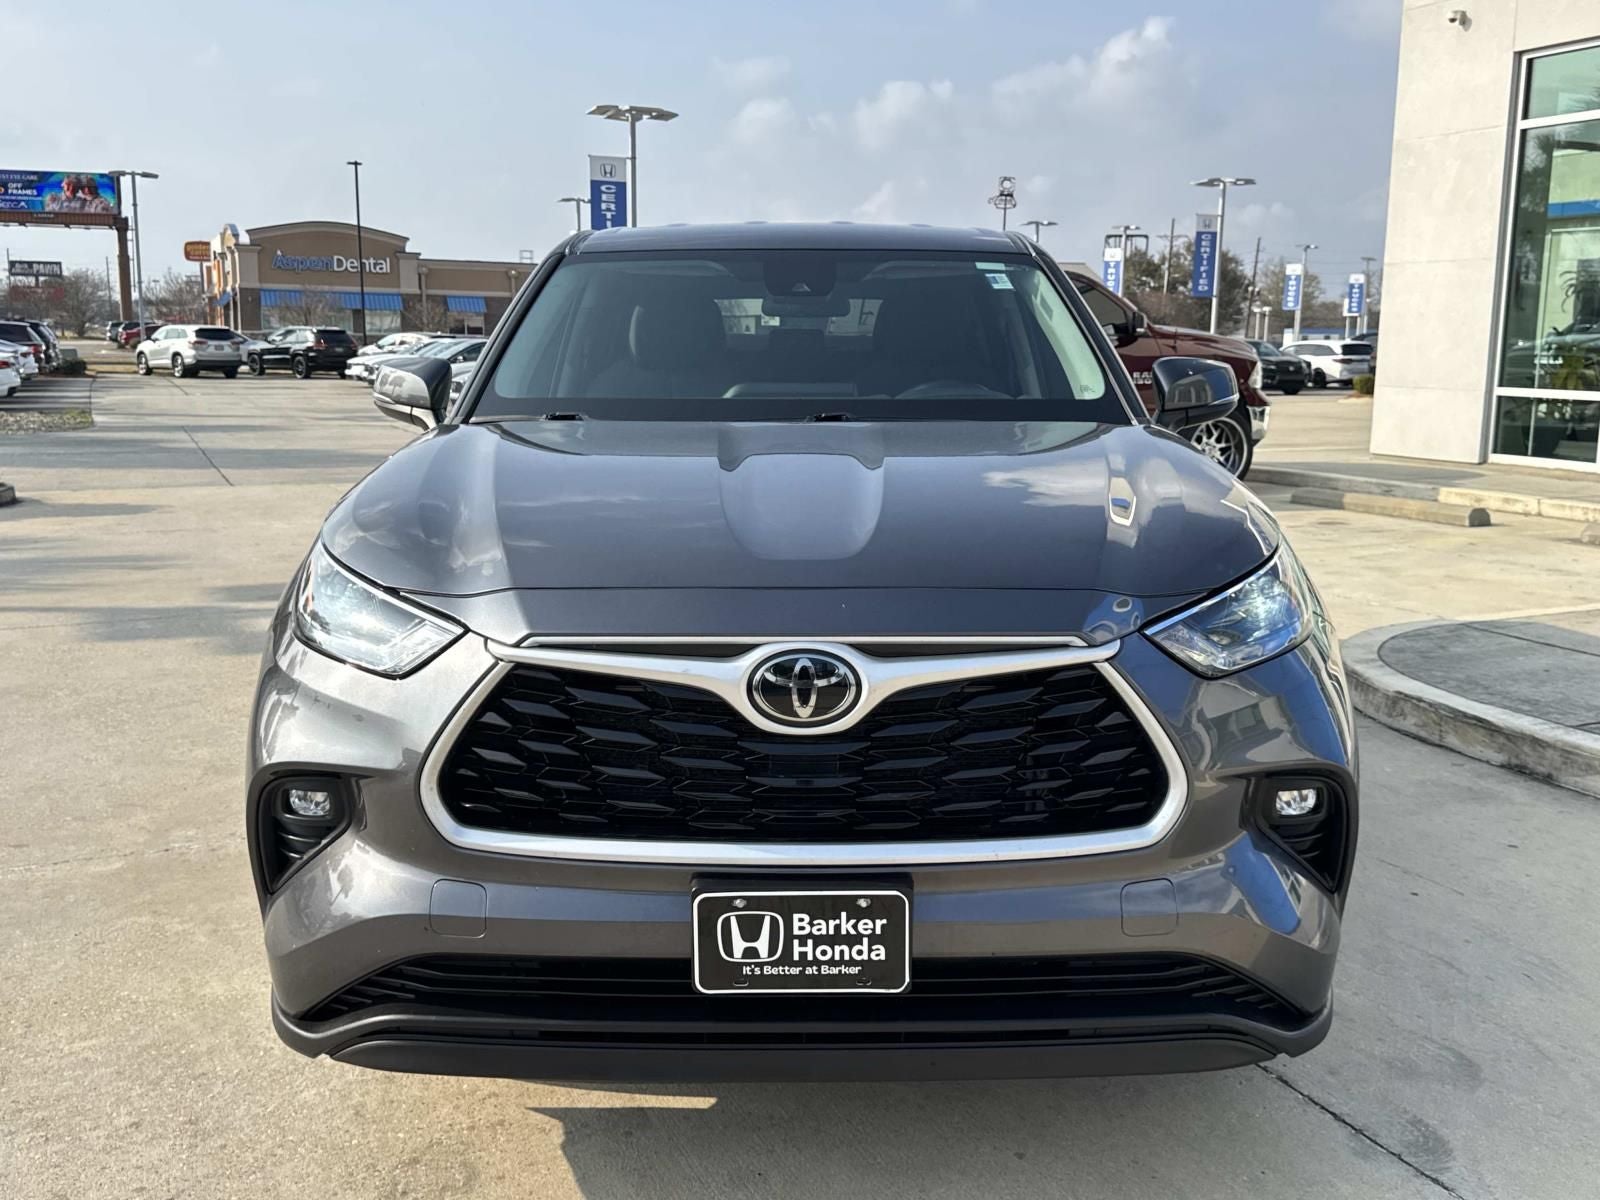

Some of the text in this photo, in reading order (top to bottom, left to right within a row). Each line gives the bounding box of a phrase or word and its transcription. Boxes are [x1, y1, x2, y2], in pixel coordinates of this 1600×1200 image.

[1198, 233, 1212, 292] CERTIFIED
[792, 911, 887, 935] Barker
[793, 937, 886, 961] Honda
[743, 965, 862, 975] It's Better at Barker
